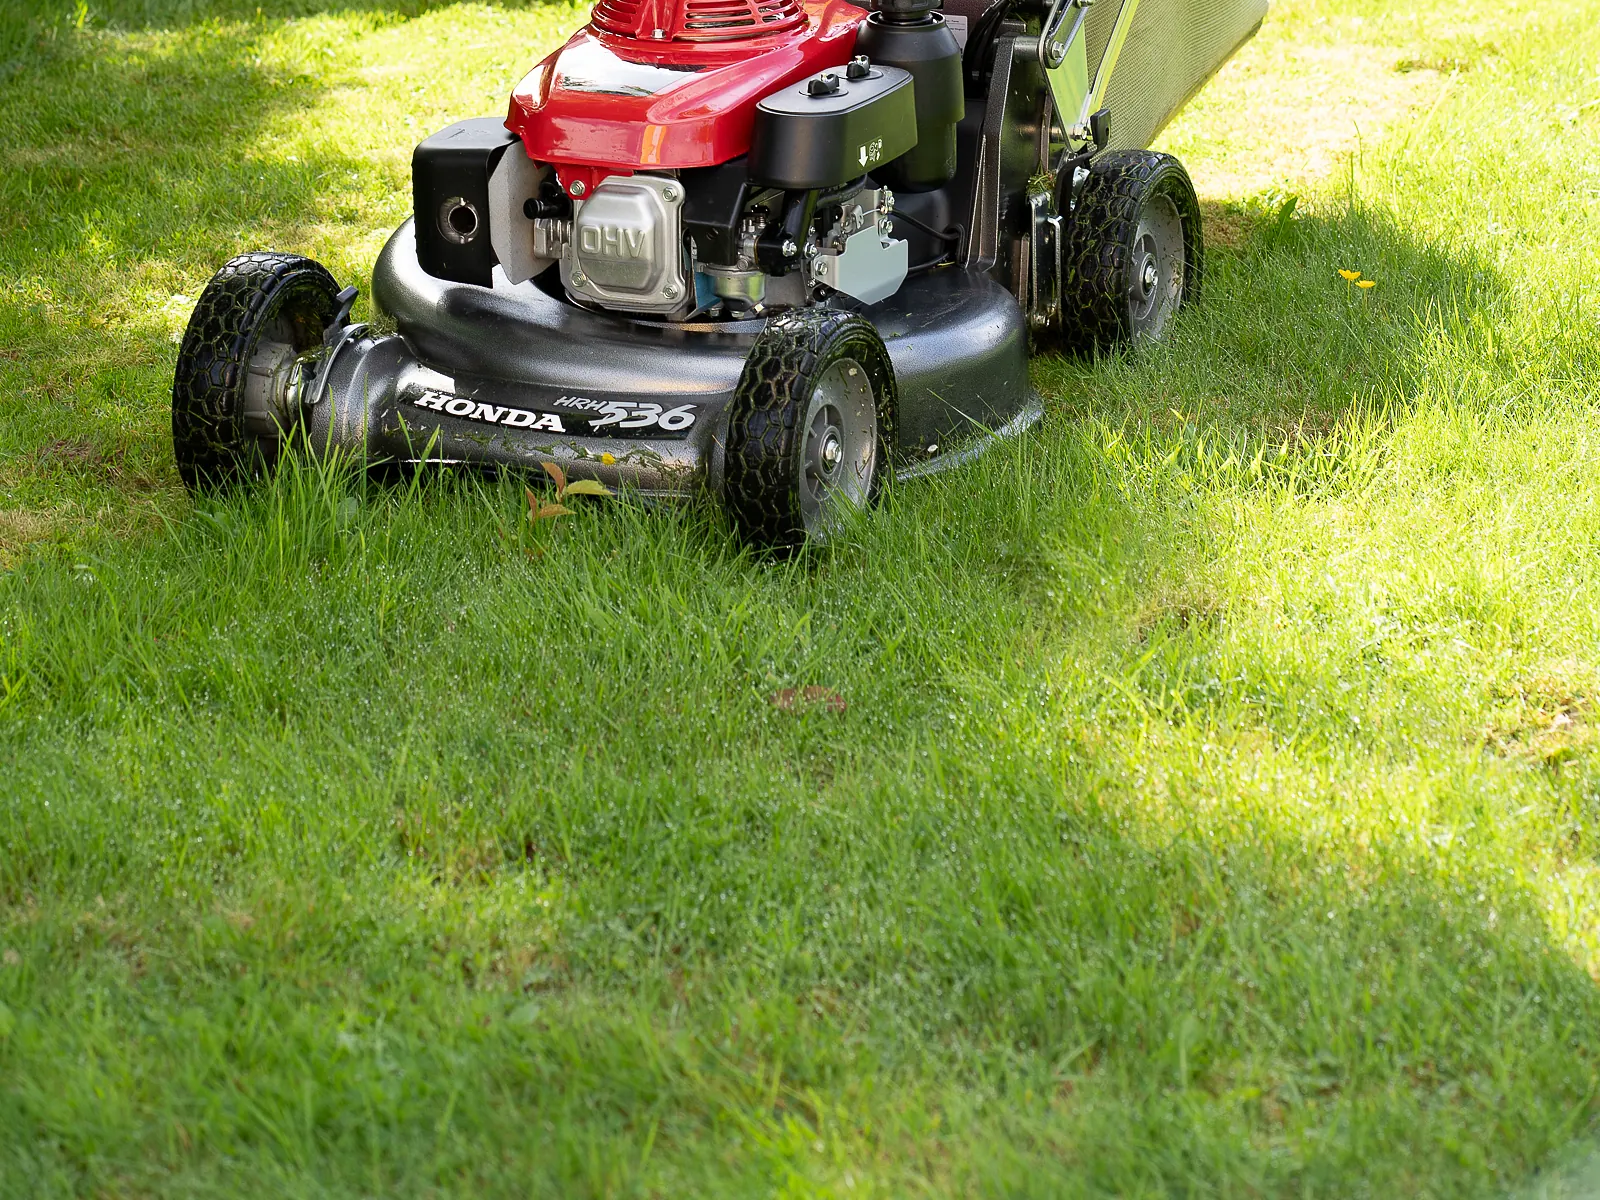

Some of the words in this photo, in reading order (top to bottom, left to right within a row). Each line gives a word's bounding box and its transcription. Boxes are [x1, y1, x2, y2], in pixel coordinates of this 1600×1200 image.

[580, 224, 646, 258] OHV
[413, 390, 567, 433] HONDA
[588, 400, 699, 431] 536
